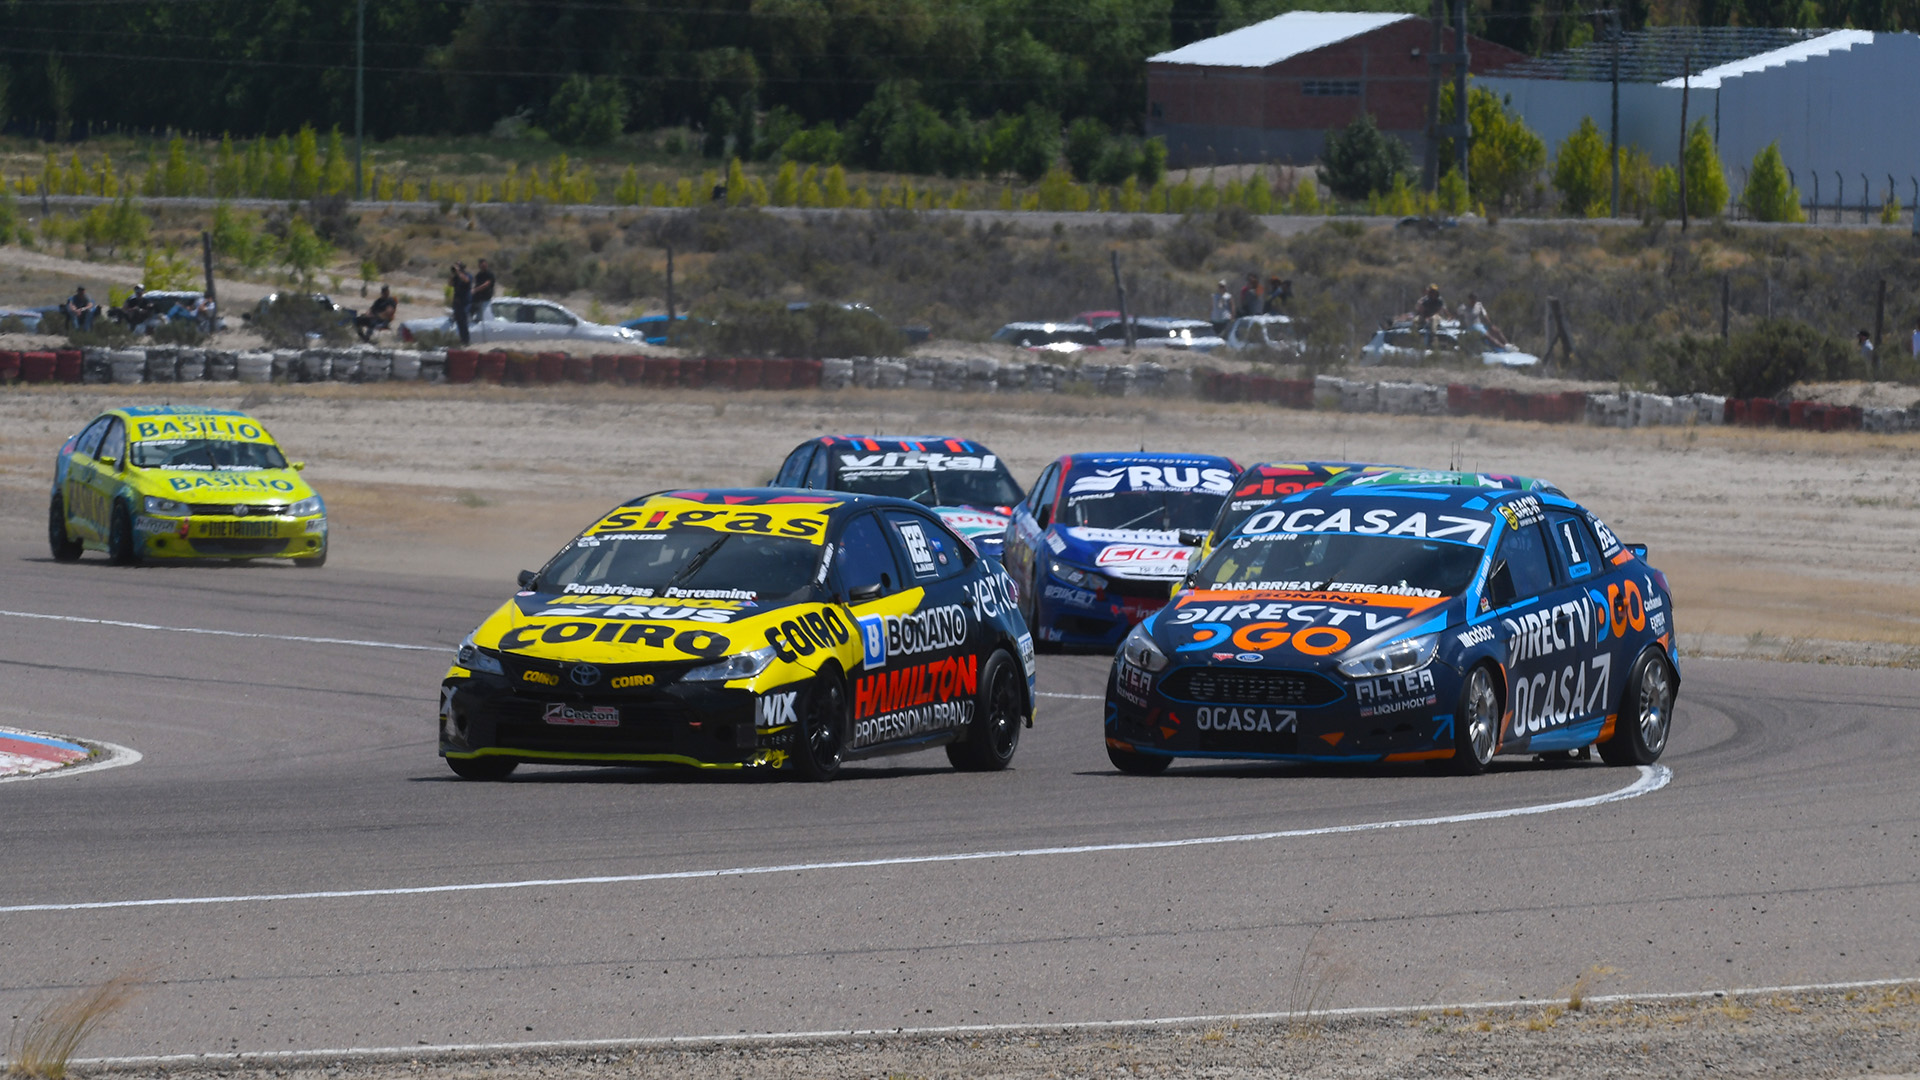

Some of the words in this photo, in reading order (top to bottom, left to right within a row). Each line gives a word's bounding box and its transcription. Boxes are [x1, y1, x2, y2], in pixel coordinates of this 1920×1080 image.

[137, 421, 261, 440] BASILIO
[168, 477, 294, 492] BASILIO
[1127, 466, 1234, 492] RUS
[599, 508, 824, 541] sigas
[1242, 508, 1427, 538] OCASA
[1563, 523, 1581, 563] 1
[563, 582, 654, 597] Parabrisas
[664, 587, 757, 600] Pergamino
[1327, 582, 1442, 598] PERGAMINO
[603, 605, 737, 624] RUS
[498, 622, 731, 658] COIRO
[764, 606, 850, 664] COIRO
[885, 604, 967, 656] BONANO
[1502, 597, 1590, 669] DIRECTV
[522, 670, 560, 686] COIRO
[610, 674, 655, 689] COIRO
[855, 654, 978, 720] HAMILTON
[755, 691, 798, 726] WIX
[1513, 660, 1585, 738] OCASA
[1197, 707, 1272, 732] OCASA
